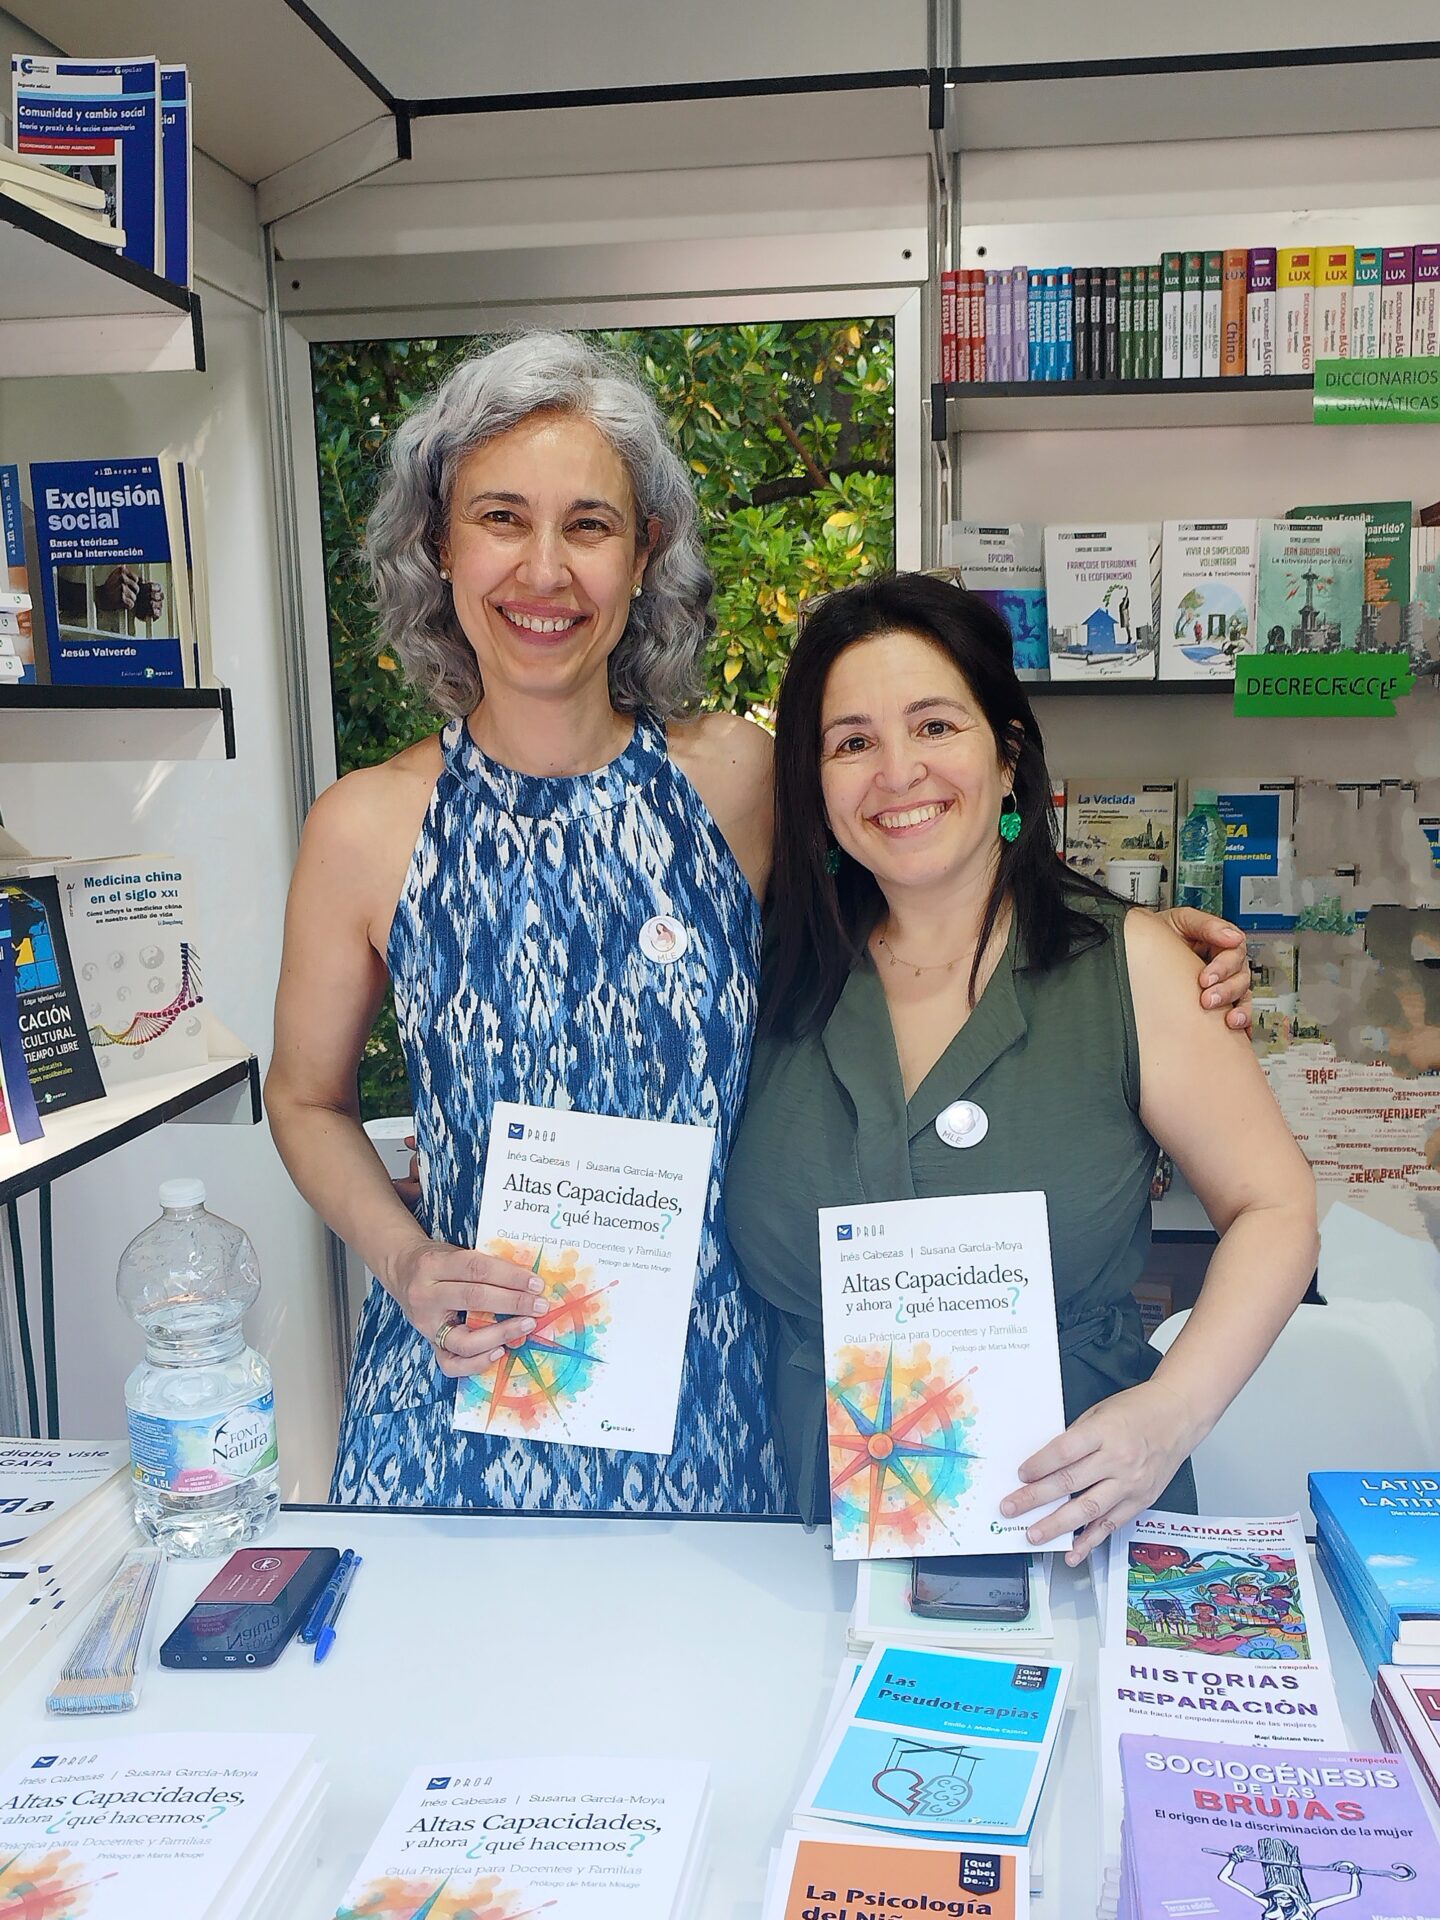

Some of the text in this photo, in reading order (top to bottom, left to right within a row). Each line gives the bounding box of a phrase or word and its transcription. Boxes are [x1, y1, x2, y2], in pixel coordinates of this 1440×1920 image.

[19, 106, 73, 119] Comunidad
[85, 107, 118, 119] cambio
[121, 106, 146, 119] social
[1289, 271, 1310, 281] LUX
[1325, 270, 1347, 281] LUX
[1356, 269, 1378, 280] LUX
[1385, 269, 1406, 280] LUX
[1418, 266, 1439, 277] LUX
[1165, 276, 1179, 285] LUX
[1251, 277, 1272, 287] LUX
[1302, 335, 1311, 370] BÁSICO
[1325, 370, 1438, 387] DICCIONARIOS
[45, 484, 161, 510] Exclusión
[48, 508, 120, 531] social
[50, 537, 119, 548] Bases teóricas
[1203, 546, 1211, 555] LA
[51, 547, 144, 561] para la intervención
[1067, 560, 1099, 570] FRANÇOISE
[1089, 571, 1133, 581] ECOFEMINISMO
[61, 646, 137, 658] Jesús Valverde
[1078, 794, 1136, 805] La Vaciada
[84, 871, 183, 889] Medicina china
[90, 888, 179, 904] en el siglo XXI
[56, 1040, 80, 1055] LIBRE
[942, 1130, 963, 1144] MLE
[507, 1149, 684, 1181] Inés Cabezas Susana García-Moya
[502, 1173, 683, 1216] Altas Capacidades,
[503, 1198, 673, 1240] y ahora ¿qué hacemos?
[856, 1224, 885, 1237] PROA
[497, 1228, 627, 1254] Guía Práctica para Docentes
[840, 1241, 1023, 1262] Inés Cabezas Susana García-Moya
[842, 1263, 1030, 1294] Altas Capacidades,
[845, 1286, 1020, 1324] y ahora ¿qué hacemos?
[843, 1324, 1029, 1344] Guía Práctica para Docentes y Familias
[230, 1422, 260, 1443] FONT
[213, 1432, 268, 1465] Natura
[153, 1479, 172, 1490] 1,5L
[1135, 1519, 1283, 1537] LAS LATINAS SON
[885, 1673, 917, 1688] Las
[1130, 1665, 1300, 1690] HISTORIAS
[1203, 1686, 1228, 1696] DE
[878, 1689, 1040, 1720] Pseudoterapias
[1117, 1688, 1318, 1716] REPARACIÓN
[1349, 1756, 1399, 1765] rompeolas
[19, 1767, 259, 1786] Inés Susana García-Moya
[1144, 1752, 1400, 1790] SOCIOGÉNESIS
[0, 1786, 247, 1811] Altas Capacidades,
[1232, 1781, 1316, 1799] DE LAS
[420, 1793, 665, 1808] Inés Cabezas Susana García-Moya
[1193, 1789, 1366, 1822] BRUJAS
[2, 1805, 228, 1835] ahora ¿qué hacemos?
[406, 1812, 663, 1835] Altas Capacidades,
[1155, 1809, 1413, 1842] El origen de la discriminación de la mujer
[48, 1836, 145, 1850] para Docentes
[400, 1833, 646, 1859] y ahora ¿qué hacemos?
[384, 1863, 643, 1878] Guía Práctica para Docentes y Familias
[965, 1859, 992, 1868] [Qué
[963, 1868, 996, 1877] Sabes
[806, 1885, 992, 1917] La Psicología
